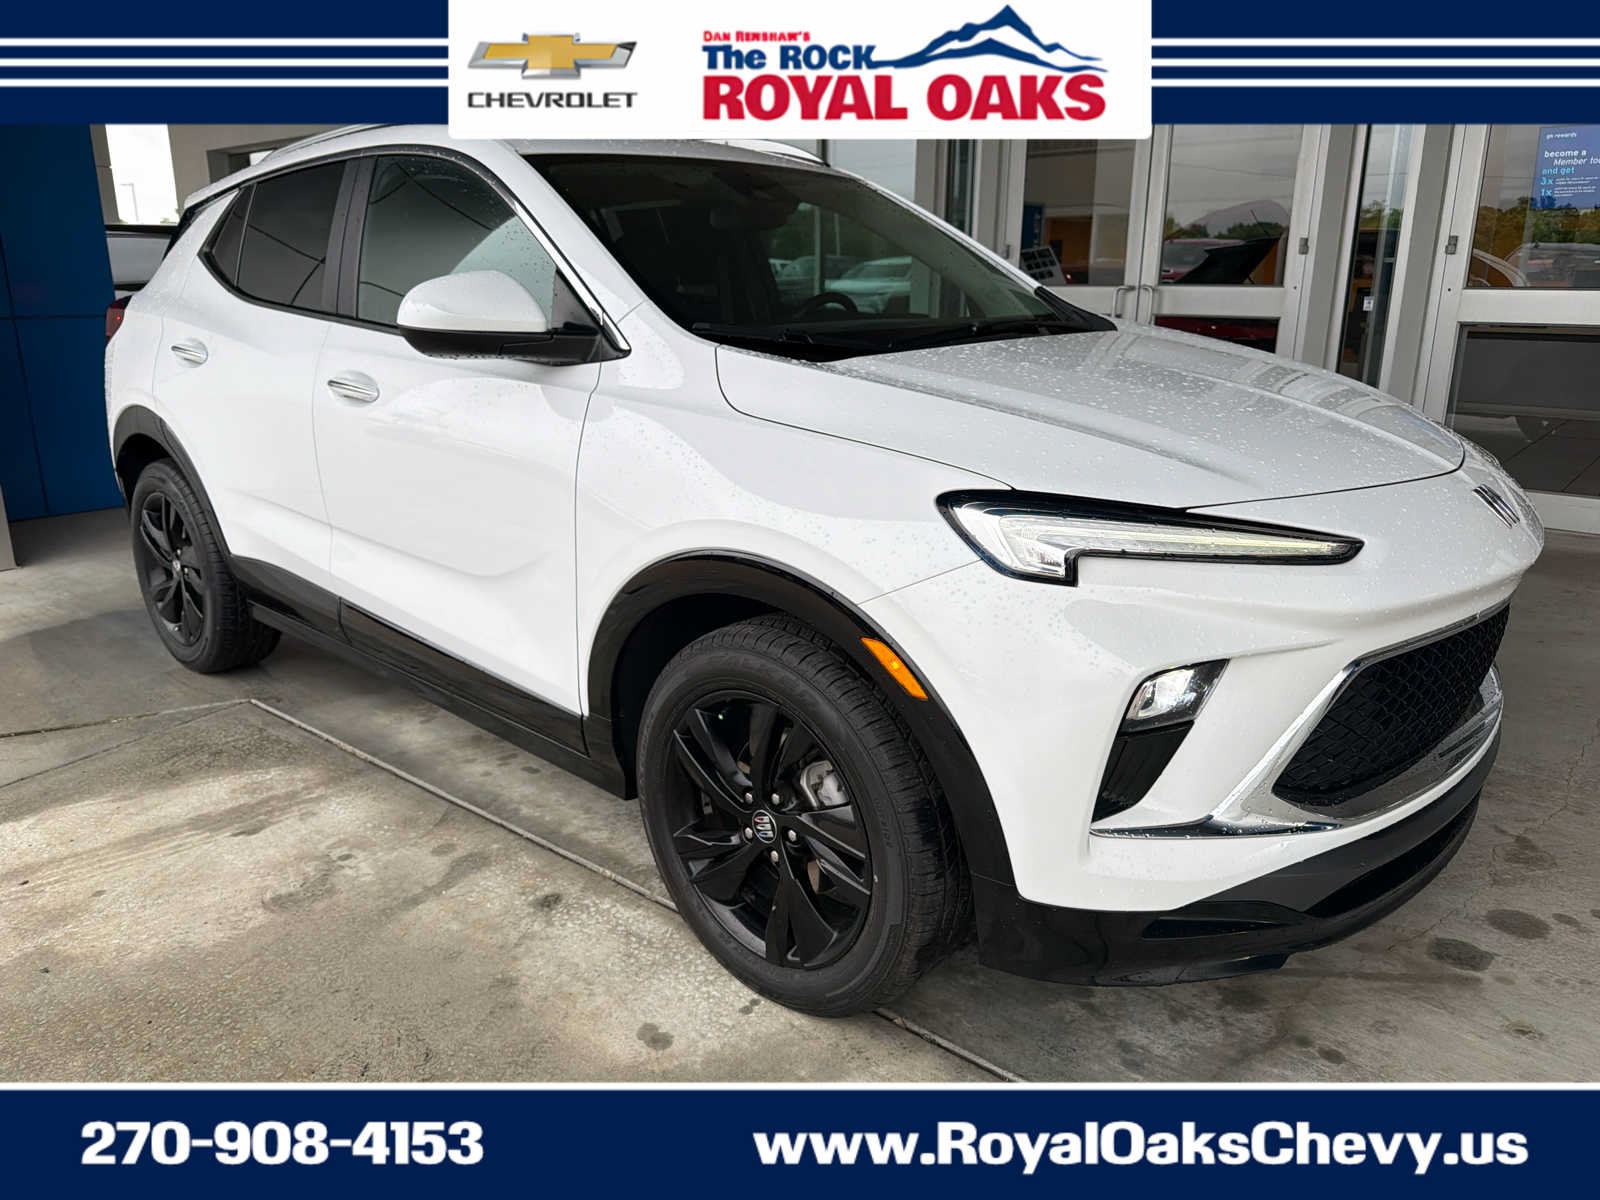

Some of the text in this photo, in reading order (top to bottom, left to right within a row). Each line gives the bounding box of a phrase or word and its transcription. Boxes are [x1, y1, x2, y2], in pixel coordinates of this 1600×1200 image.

[1544, 150, 1579, 158] become
[1553, 158, 1587, 166] Member
[1542, 167, 1575, 175] and get
